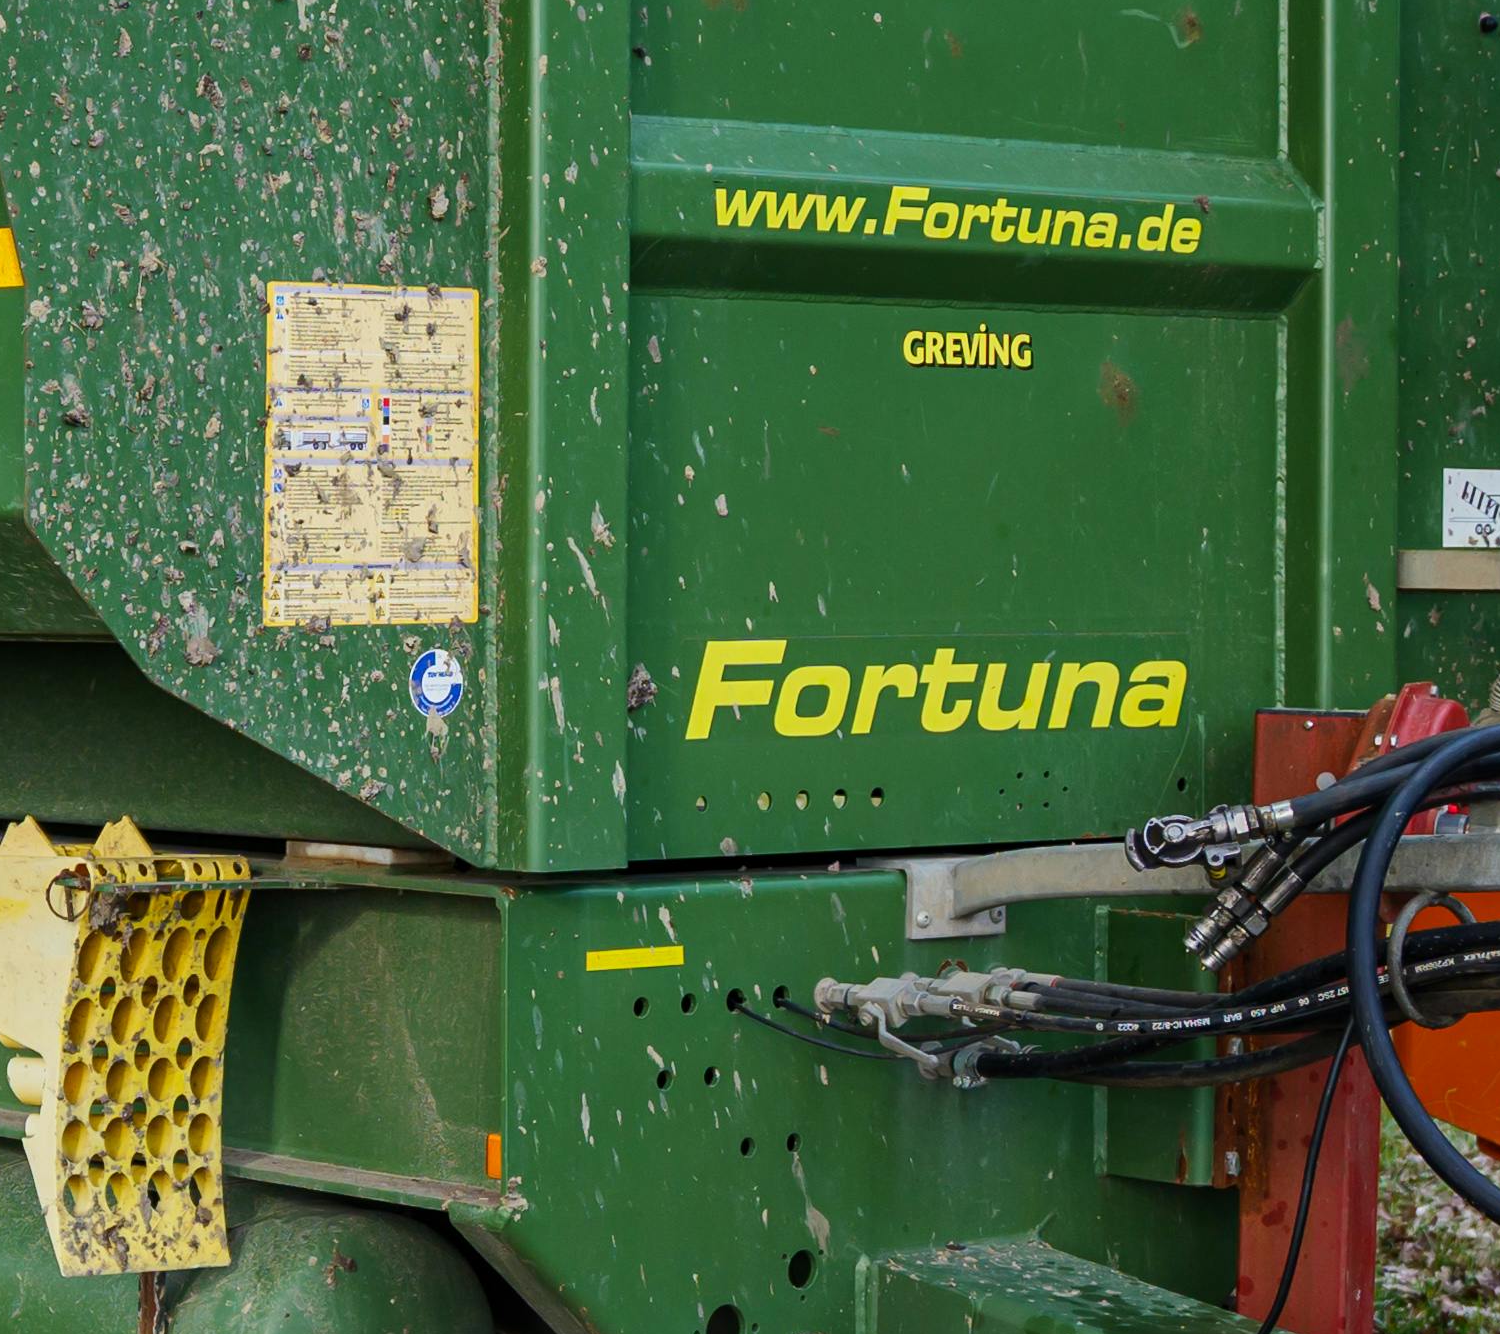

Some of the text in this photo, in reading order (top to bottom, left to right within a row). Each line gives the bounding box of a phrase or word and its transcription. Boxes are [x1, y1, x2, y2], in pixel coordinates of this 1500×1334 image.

[713, 185, 1203, 255] www.Fortuna.de
[684, 638, 1189, 740] Fortuna
[1270, 1003, 1287, 1015] WP
[1183, 1017, 1211, 1028] MSHA
[1223, 1012, 1243, 1023] BAR
